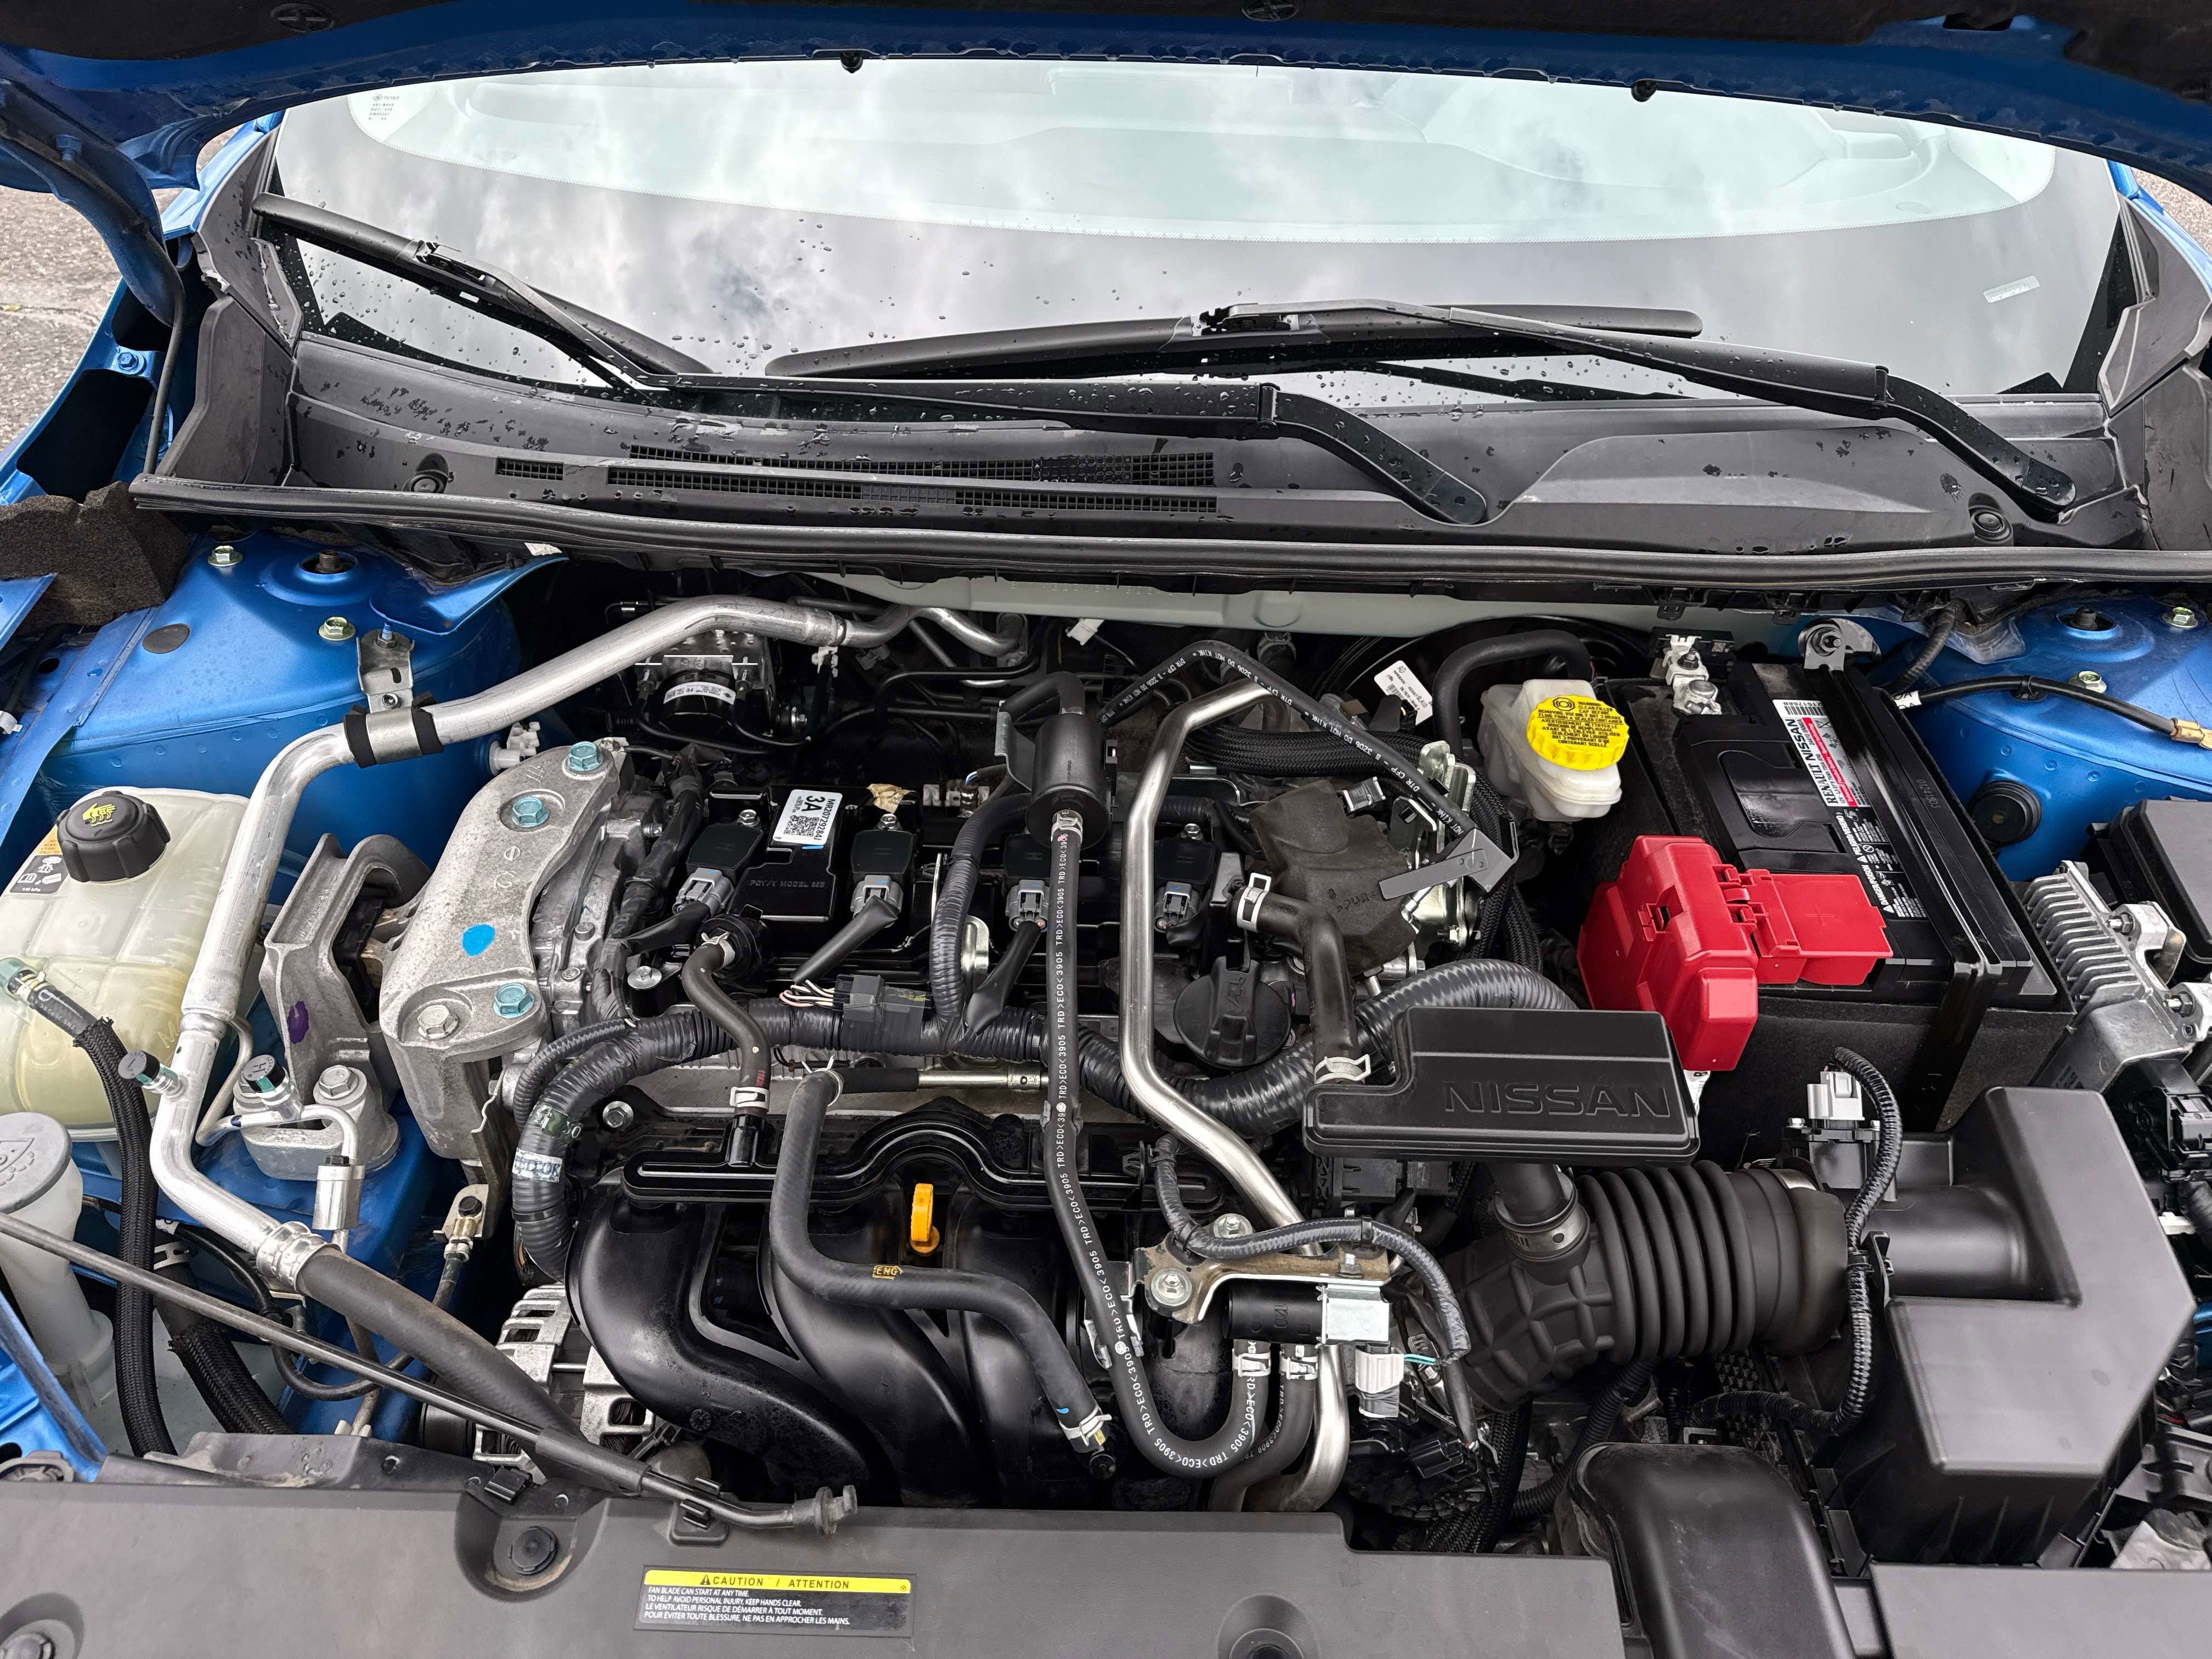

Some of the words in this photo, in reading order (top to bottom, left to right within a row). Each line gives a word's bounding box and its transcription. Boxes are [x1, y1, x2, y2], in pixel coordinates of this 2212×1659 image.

[1175, 658, 1186, 667] DTR
[1215, 652, 1225, 661] NOT
[1267, 686, 1278, 696] CFP
[1280, 694, 1292, 706] DTR
[1312, 714, 1327, 728] KINK
[1330, 728, 1341, 737] NOT
[1784, 719, 1815, 760] NISSAN
[1391, 767, 1406, 779] CFP
[1406, 778, 1420, 792] DTR
[1808, 764, 1838, 803] RENAULT
[801, 795, 826, 812] 3A
[814, 798, 836, 840] MR20729284J
[1436, 809, 1453, 823] KINK
[1450, 823, 1464, 835] NOT
[1056, 888, 1064, 945] TRD>ECO<3905
[1056, 951, 1065, 1029] TRD>ECO<3905
[1059, 1035, 1067, 1099] TRD>ECO<3905
[1443, 1081, 1670, 1119] NISSAN
[1056, 1111, 1065, 1168] TRD>ECO<39
[1060, 1173, 1093, 1245] TRD>ECO<3905
[876, 1265, 898, 1277] ENG
[1090, 1250, 1126, 1340] TRD>ECO<3905
[1231, 1376, 1255, 1453] RD>ECO<3905
[1154, 1438, 1229, 1468] TRD>ECO<3905
[713, 1576, 764, 1586] CAUTION
[789, 1579, 849, 1589] ATTENTION
[698, 1605, 721, 1613] RISQUE
[732, 1604, 767, 1614] DÉMARRER
[664, 1611, 686, 1620] ÉVITER
[709, 1613, 741, 1622] BLESSURE,
